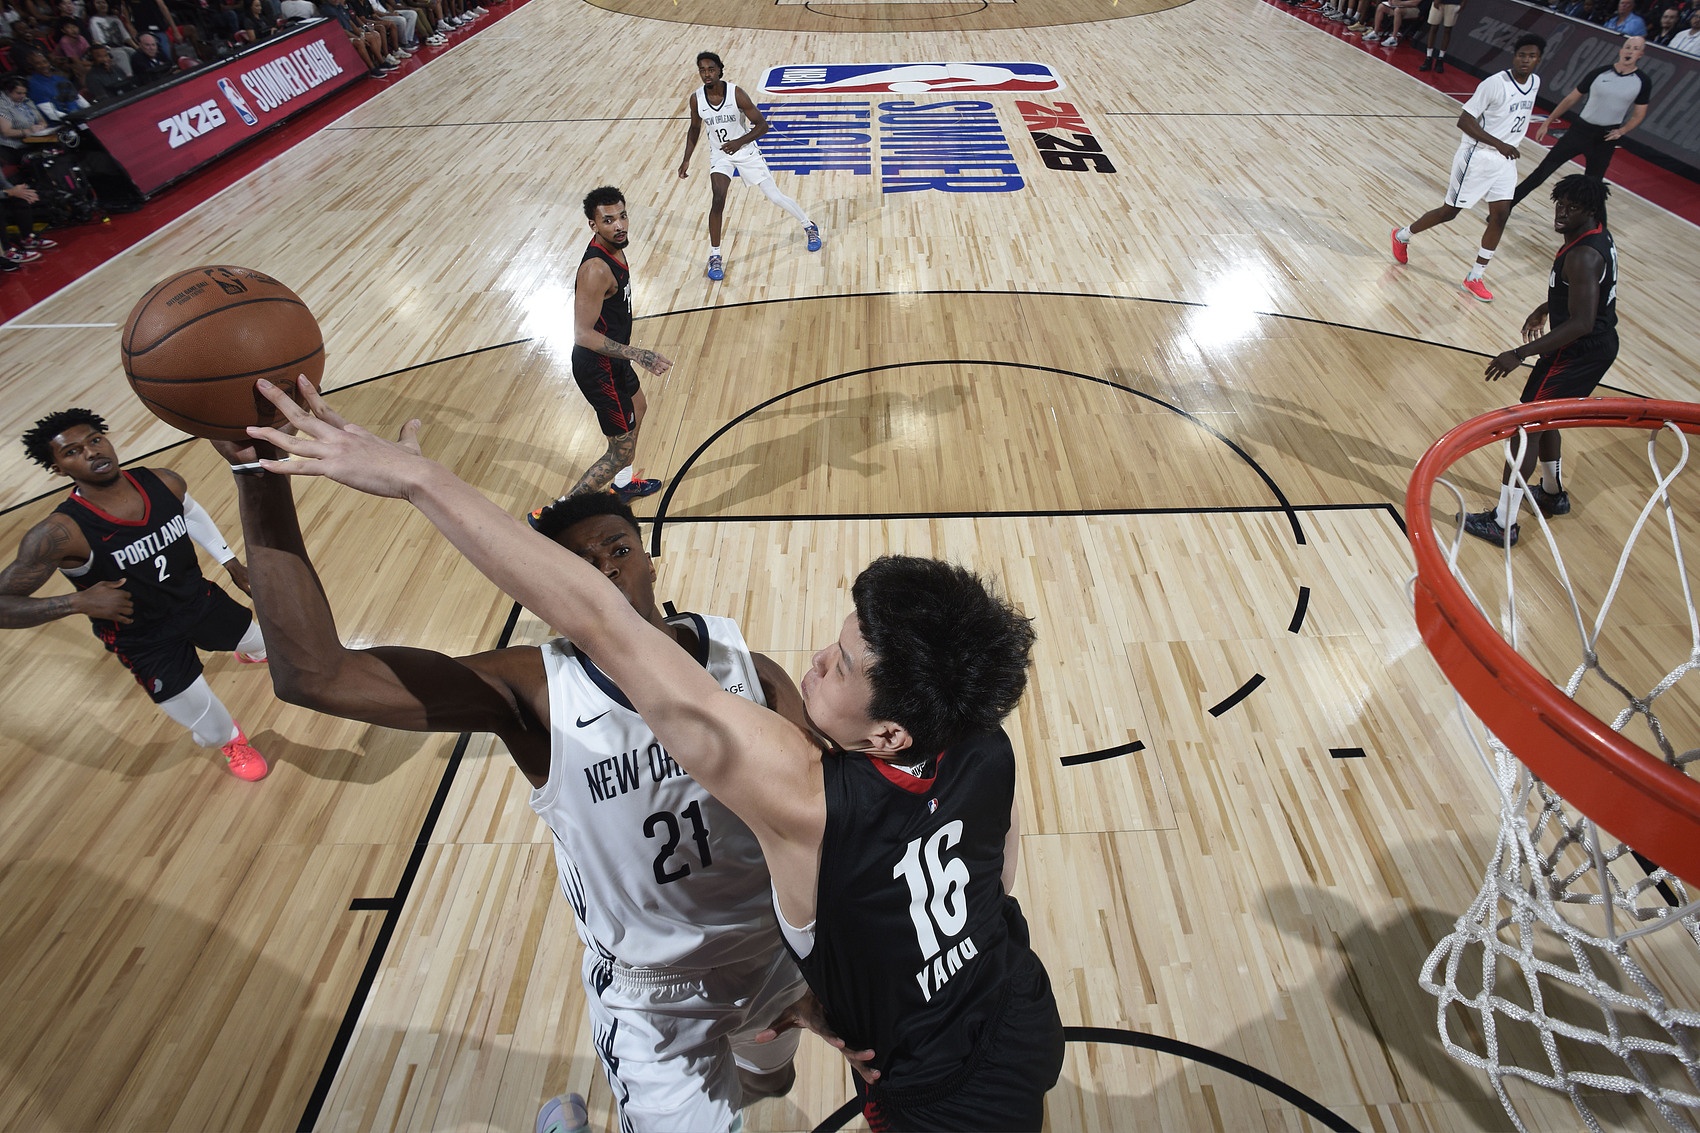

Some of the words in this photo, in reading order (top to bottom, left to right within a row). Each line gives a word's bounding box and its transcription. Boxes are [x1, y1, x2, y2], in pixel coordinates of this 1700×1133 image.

[157, 99, 227, 149] 2K26
[240, 56, 309, 113] SUMMER
[289, 39, 344, 89] LEAGUE
[781, 68, 827, 84] NBA
[714, 128, 729, 143] 12
[715, 114, 737, 124] ORLEANS
[878, 101, 1025, 193] SUMMER
[1015, 100, 1117, 174] 2K26
[1510, 116, 1526, 133] 22
[110, 514, 187, 570] PORTLAND
[154, 554, 171, 583] 2
[583, 748, 640, 804] NEW
[642, 799, 712, 885] 21
[893, 819, 970, 962] 16
